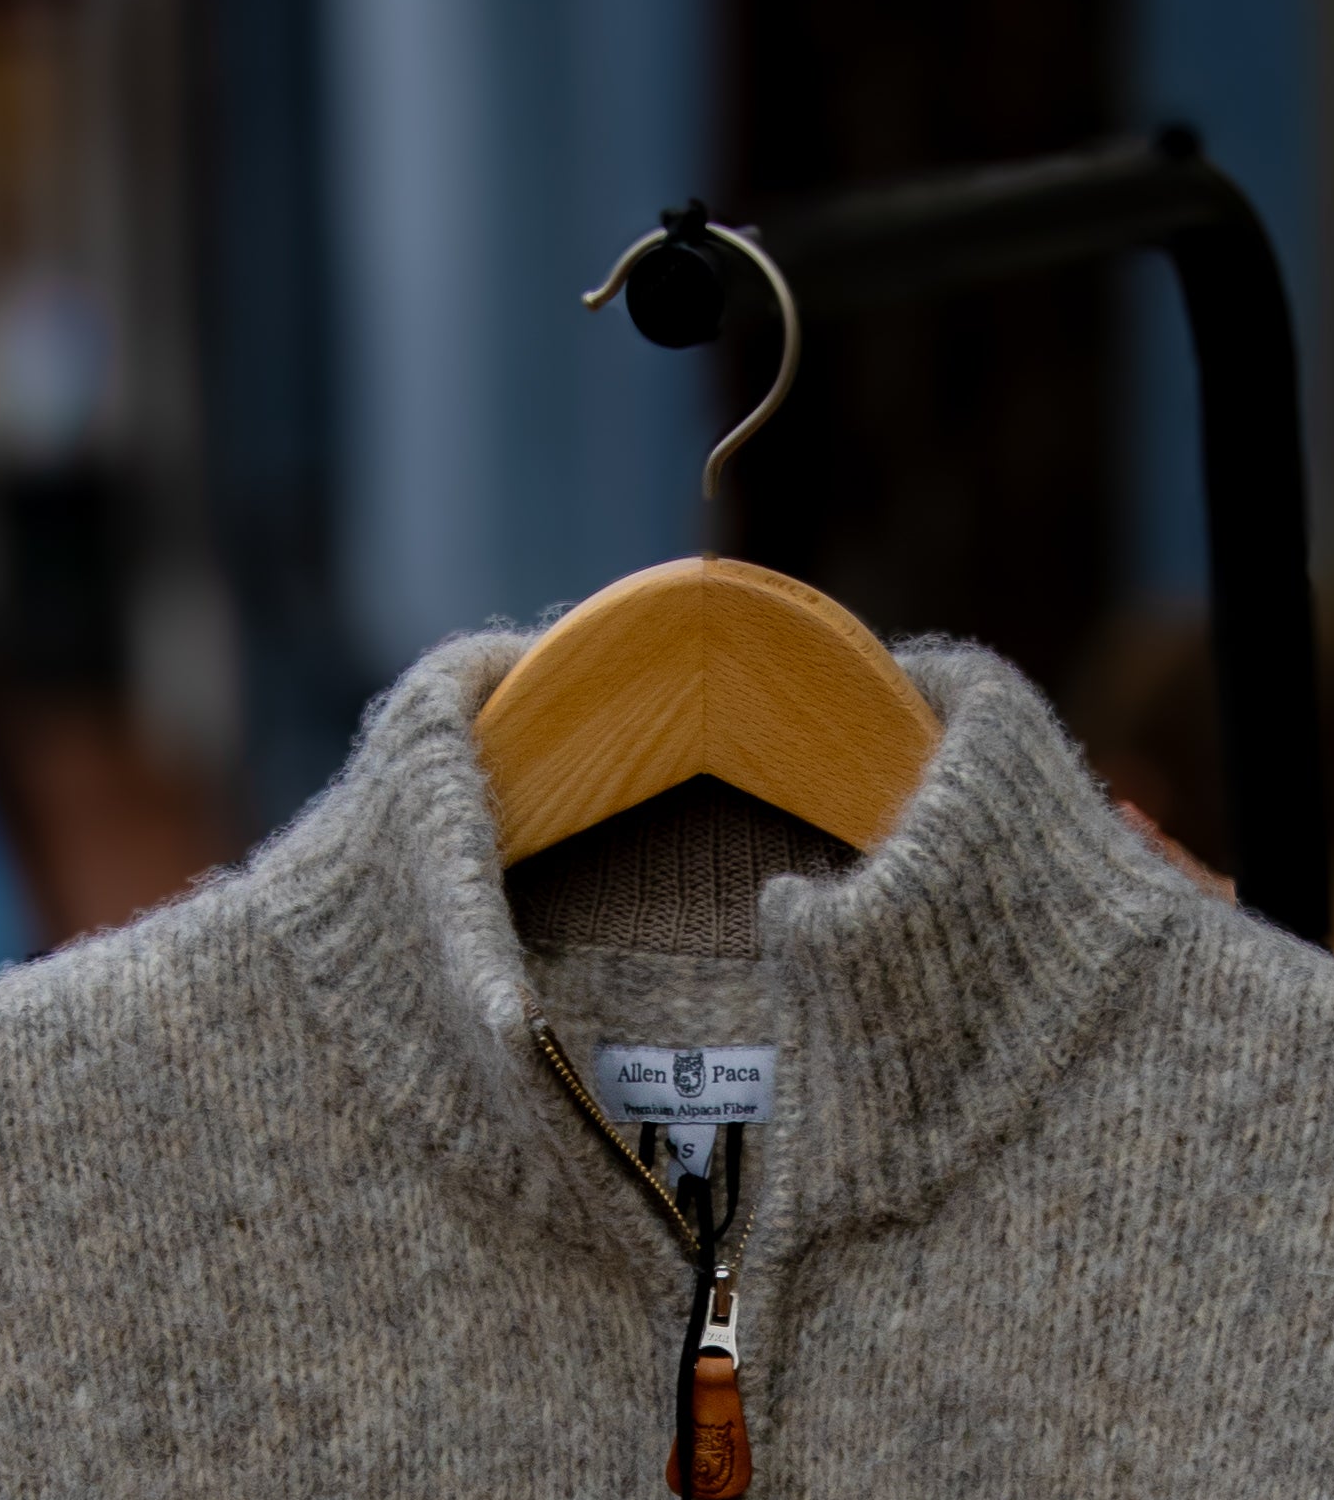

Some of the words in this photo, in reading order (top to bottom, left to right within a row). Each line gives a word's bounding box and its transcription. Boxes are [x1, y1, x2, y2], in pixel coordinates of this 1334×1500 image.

[618, 1063, 666, 1084] Allen
[712, 1065, 760, 1083] Paca
[624, 1103, 674, 1116] Premium
[677, 1104, 721, 1117] Alpaca
[723, 1103, 758, 1115] Fiber
[681, 1143, 695, 1159] S
